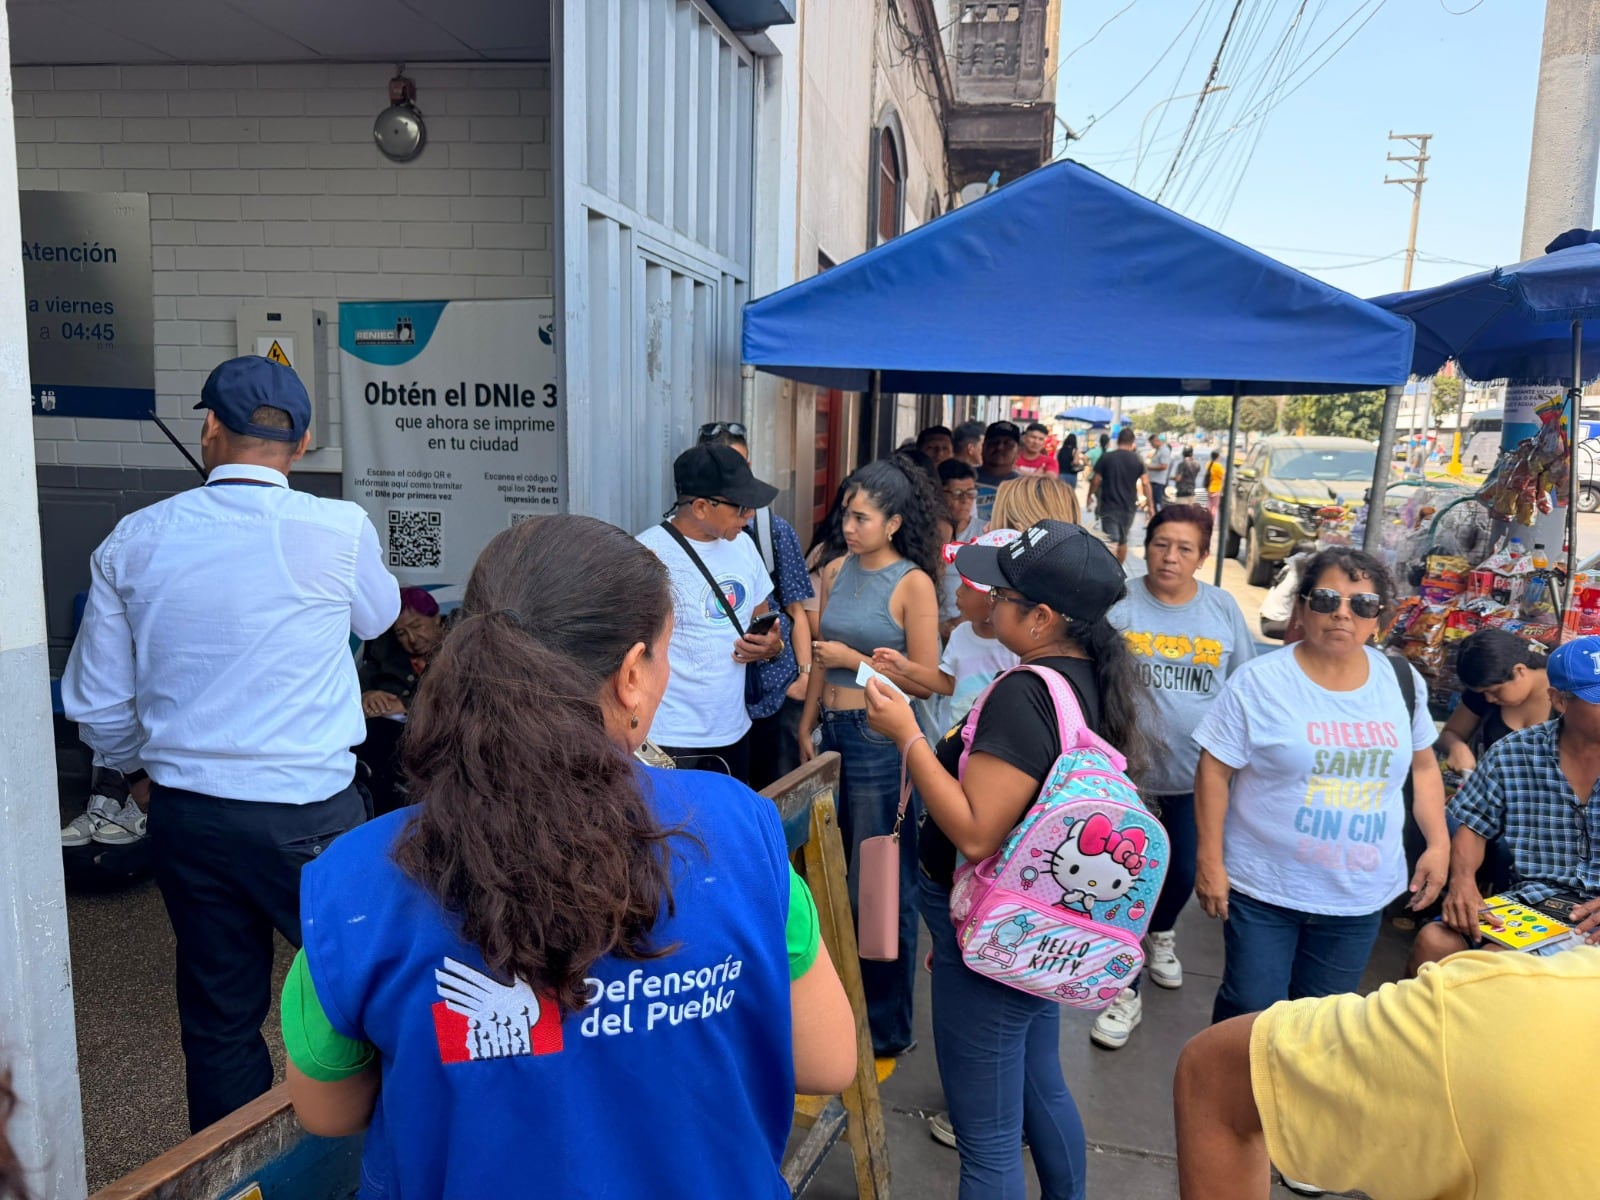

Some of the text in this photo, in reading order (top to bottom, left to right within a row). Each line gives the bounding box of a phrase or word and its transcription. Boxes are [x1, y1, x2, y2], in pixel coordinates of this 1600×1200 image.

[22, 241, 116, 264] Atención
[29, 296, 114, 315] a viernes
[40, 322, 114, 341] a 04:45
[364, 381, 558, 408] Obtén el DNIe 3
[395, 415, 556, 434] que ahora se imprime
[428, 437, 519, 452] en tu ciudad
[367, 468, 396, 476] Escanea
[407, 469, 432, 479] código
[433, 470, 445, 478] QR
[484, 472, 515, 480] Escanea
[524, 473, 549, 483] código
[550, 474, 558, 482] Q
[392, 491, 406, 500] por
[407, 491, 438, 500] primera
[433, 481, 463, 489] tramitar
[514, 484, 526, 492] los
[537, 486, 558, 494] centr
[540, 496, 551, 504] de
[1135, 662, 1214, 694] OSCHINO
[1307, 721, 1398, 748] CHEERS
[1312, 748, 1394, 778] SANTE
[1304, 776, 1388, 812] PROST
[1295, 807, 1388, 844] CIN CIN
[1037, 935, 1091, 957] HELLO
[1028, 953, 1083, 976] KITTY
[582, 954, 742, 1005] Defensoría
[581, 984, 736, 1038] del Pueblo
